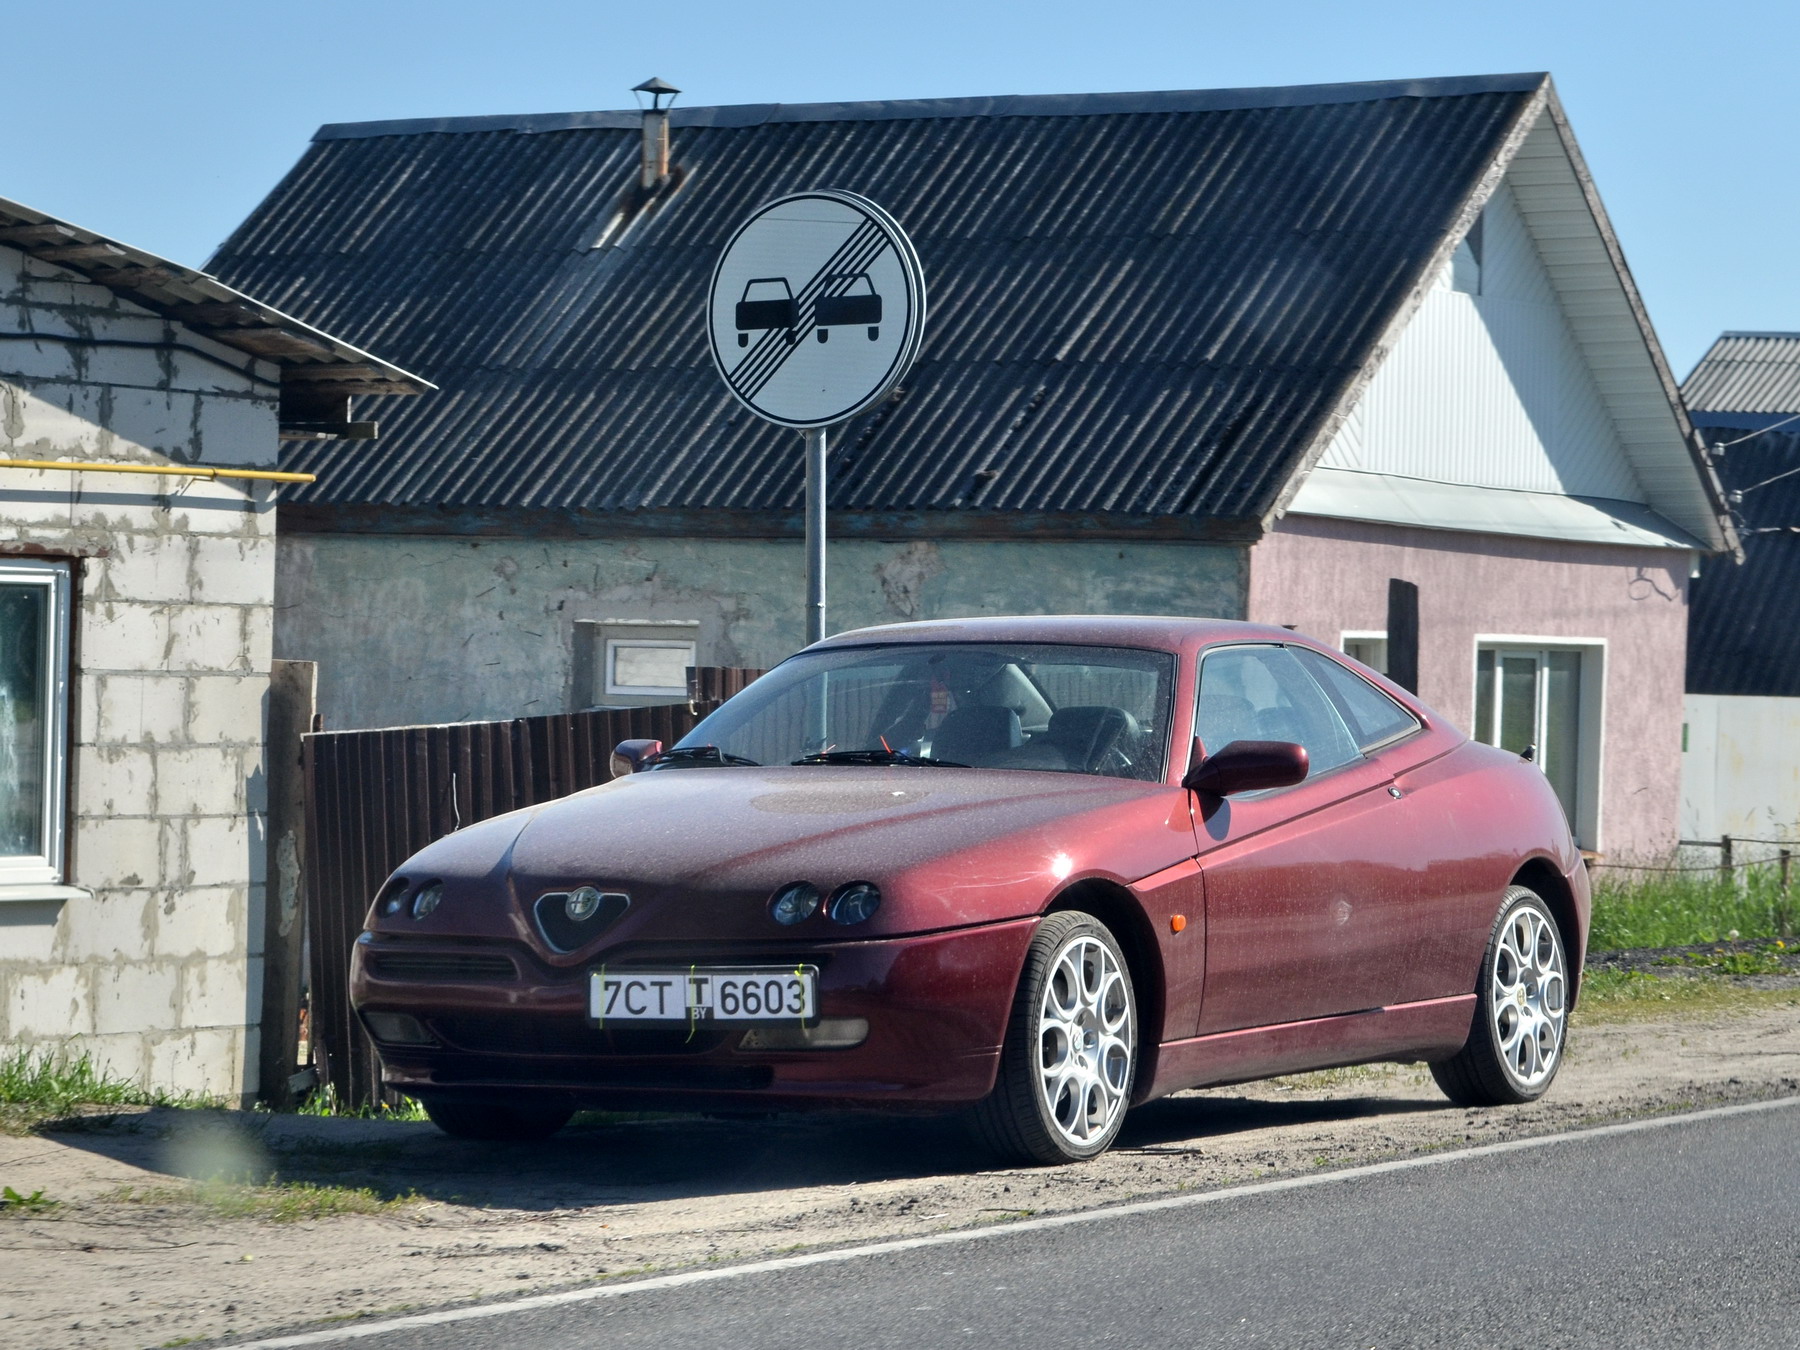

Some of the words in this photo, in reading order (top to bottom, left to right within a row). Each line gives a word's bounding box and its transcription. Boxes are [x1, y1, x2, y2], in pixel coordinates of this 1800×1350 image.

[603, 980, 673, 1016] 7CT
[688, 977, 709, 1005] T
[720, 979, 806, 1016] 6603
[691, 1007, 707, 1020] BY
